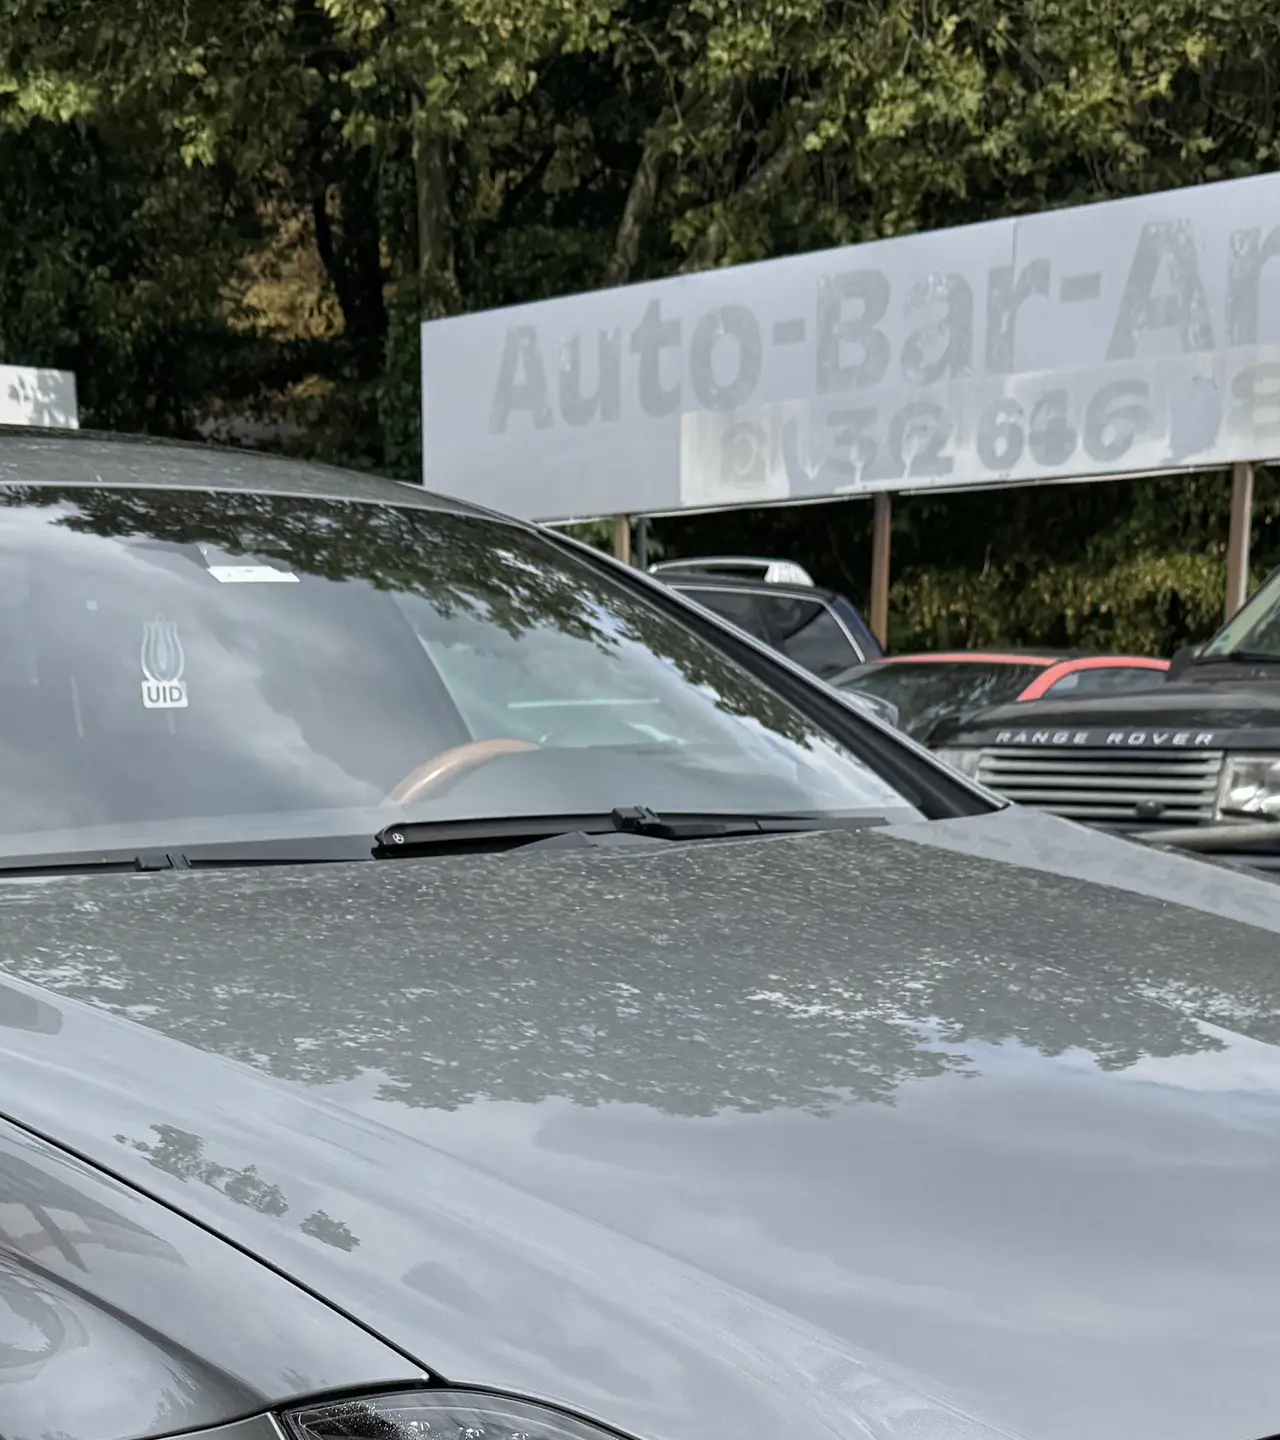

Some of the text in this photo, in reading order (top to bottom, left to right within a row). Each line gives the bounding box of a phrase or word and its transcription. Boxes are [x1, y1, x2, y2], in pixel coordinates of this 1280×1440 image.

[147, 685, 182, 703] UID
[995, 731, 1215, 746] RANGE ROVER
